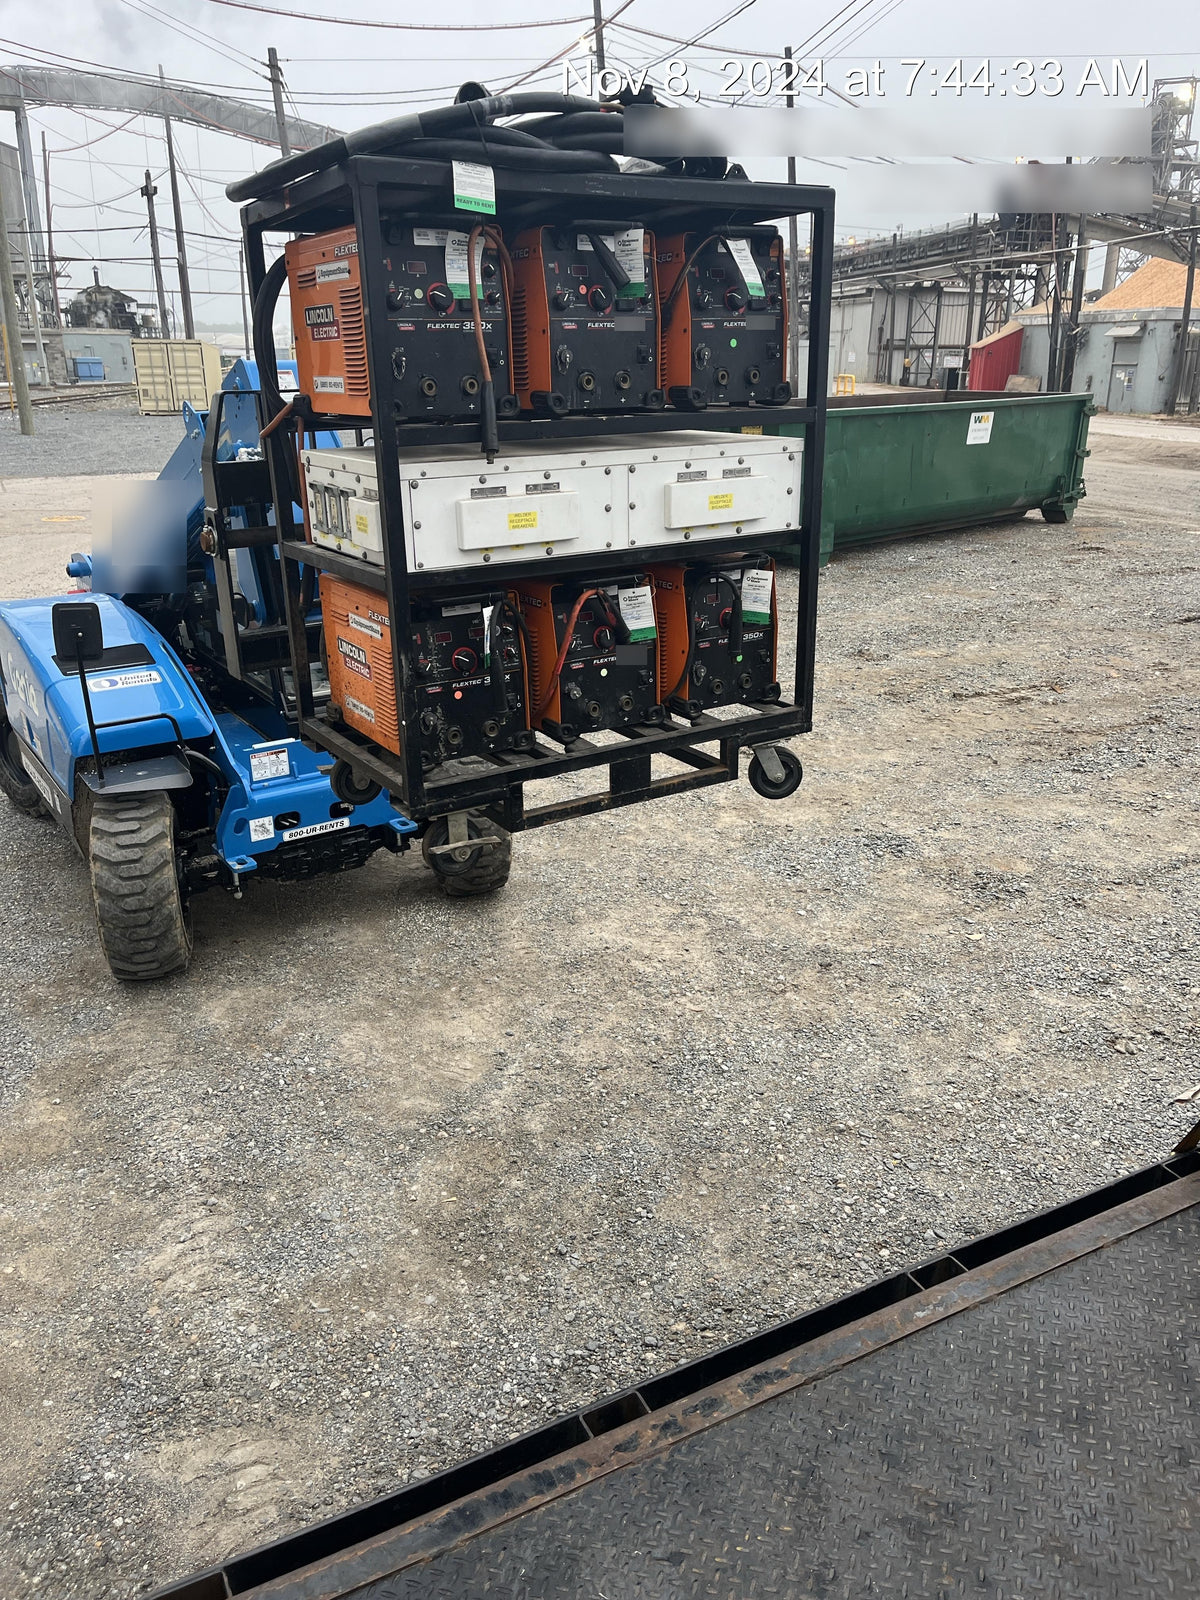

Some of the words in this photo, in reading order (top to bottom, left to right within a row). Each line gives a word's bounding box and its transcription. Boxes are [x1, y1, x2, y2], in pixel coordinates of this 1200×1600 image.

[305, 307, 334, 324] LINCOLN
[313, 326, 338, 339] ELECTRIC
[974, 415, 990, 424] WM
[368, 610, 390, 626] FLEXTE
[339, 639, 366, 663] LINCOLN
[345, 657, 370, 678] ELECTRIC
[119, 673, 152, 681] United
[121, 677, 158, 686] Rentals
[452, 679, 482, 688] FLEXTEC
[288, 820, 345, 839] 800-UR-RENTS
